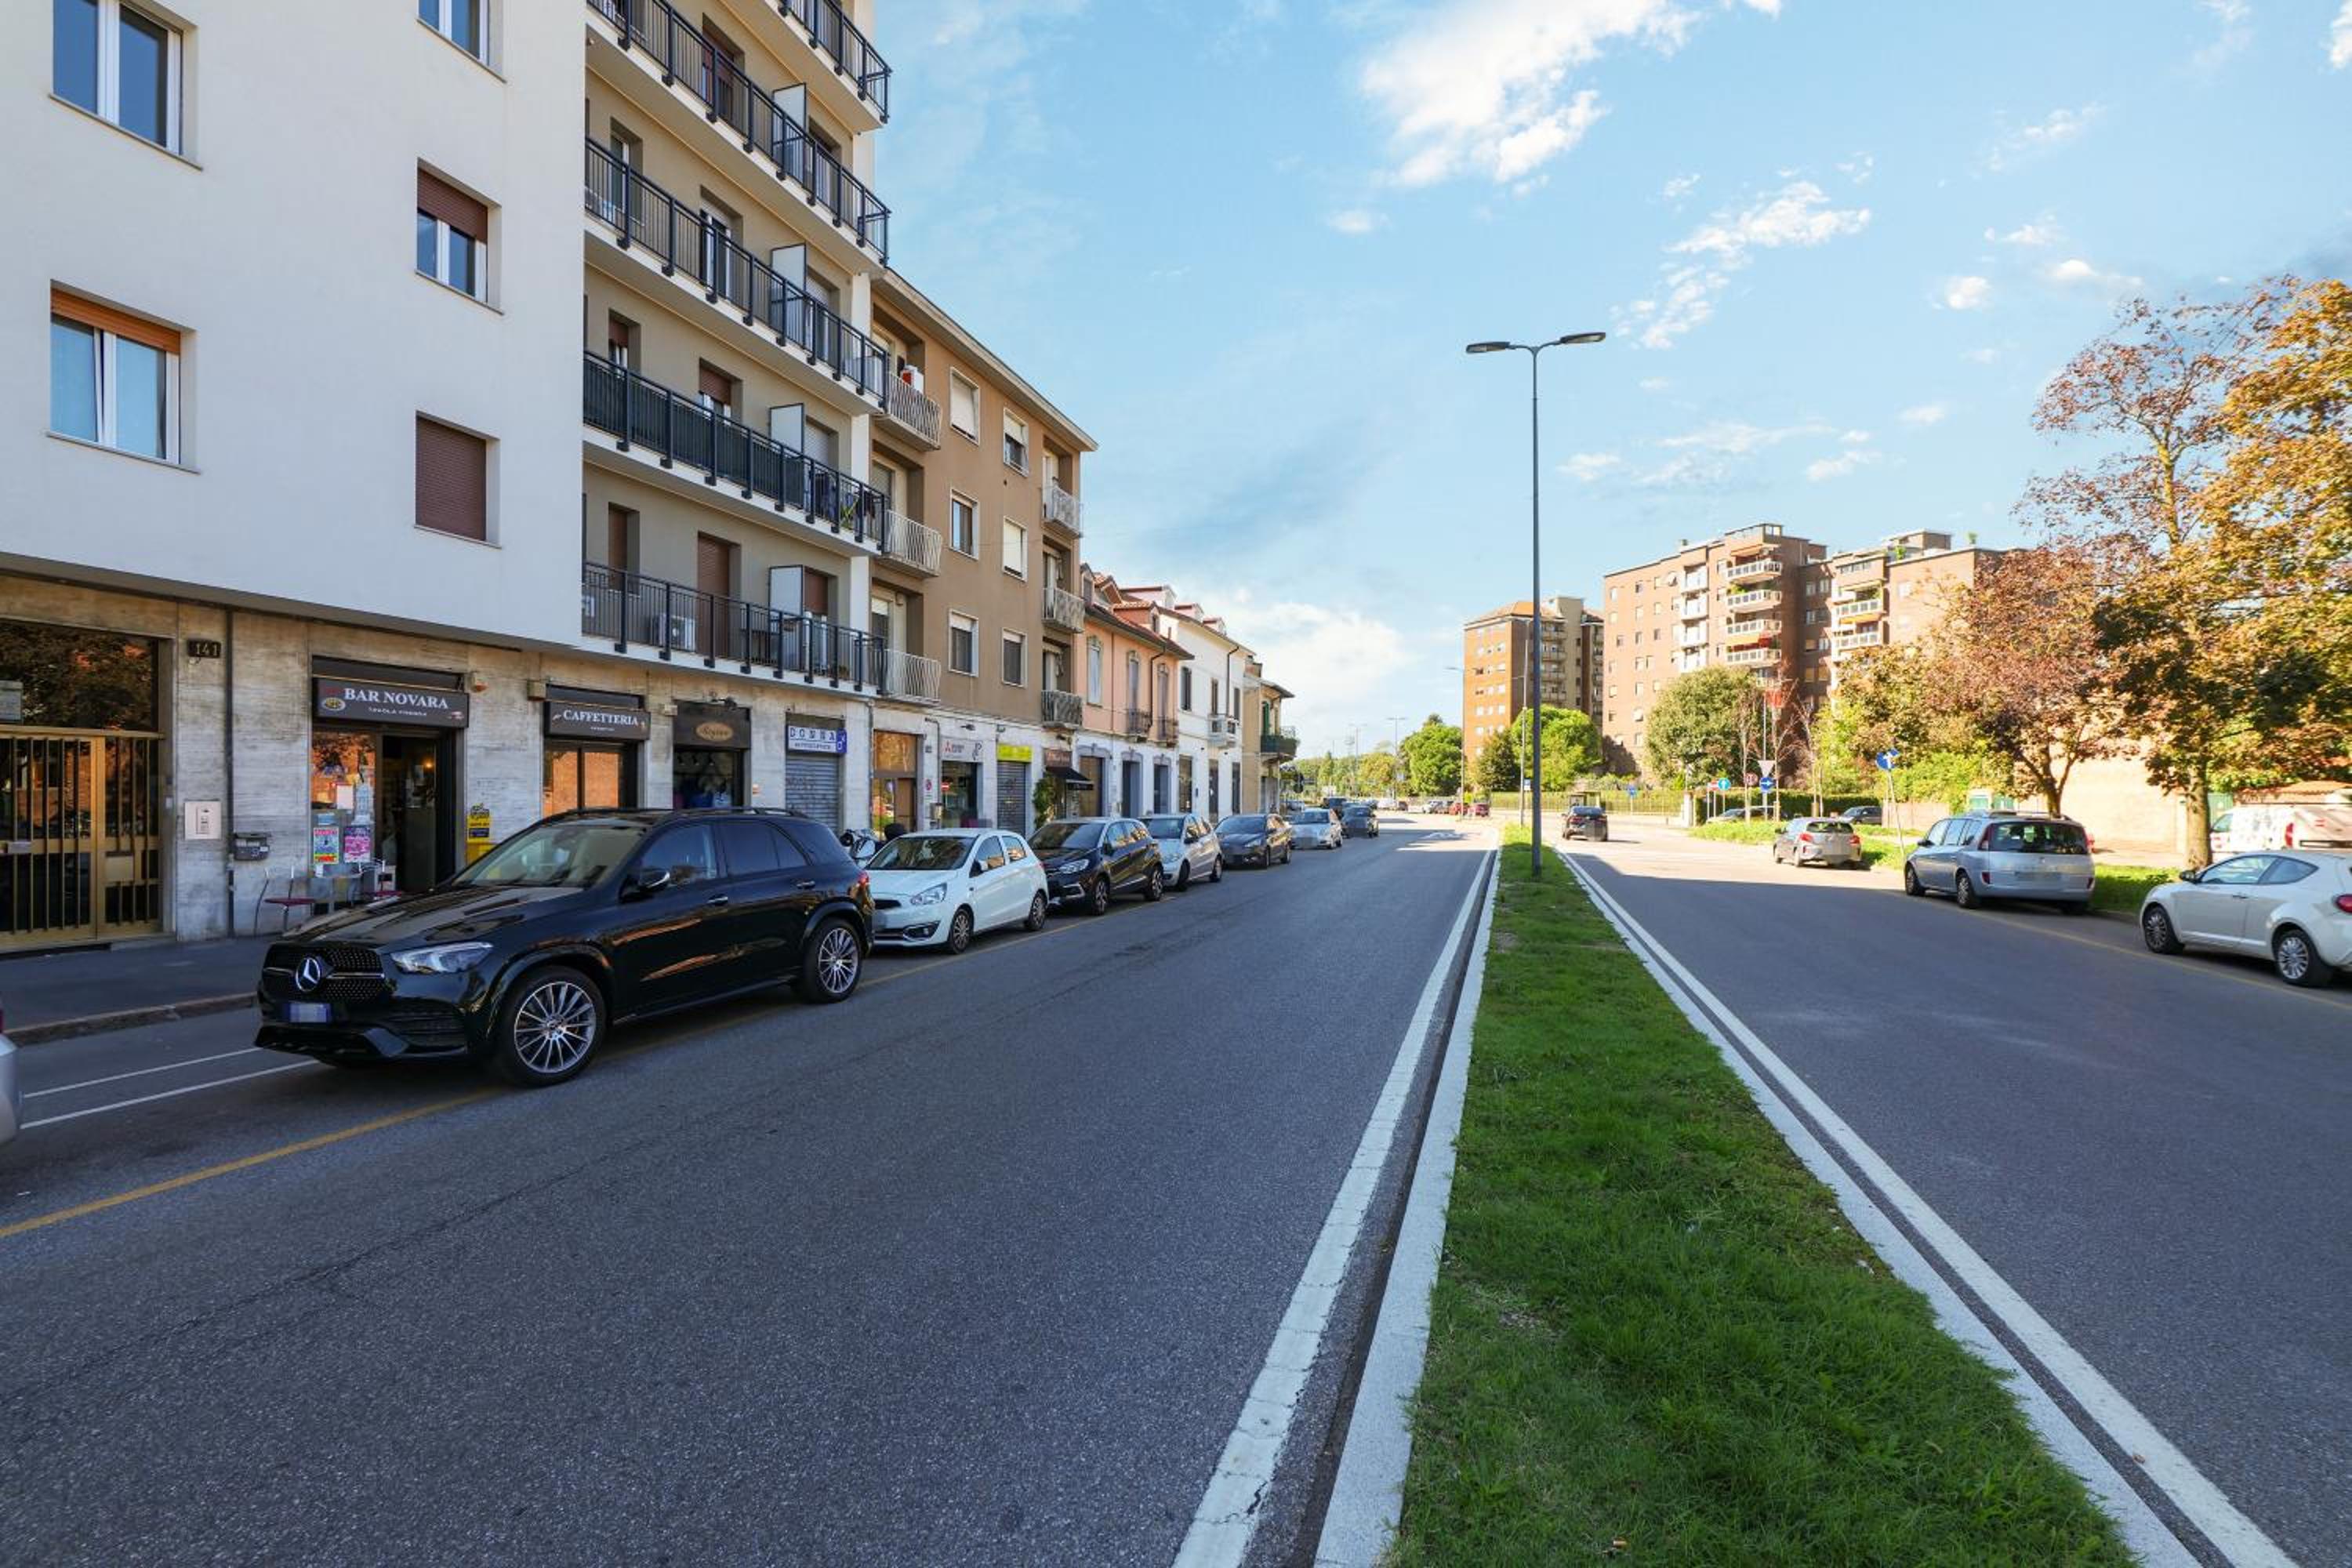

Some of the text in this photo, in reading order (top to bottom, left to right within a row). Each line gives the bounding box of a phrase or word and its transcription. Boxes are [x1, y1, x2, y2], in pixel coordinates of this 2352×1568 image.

[196, 643, 218, 656] 141
[343, 688, 449, 710] BAR NOVARA
[563, 710, 639, 726] CAFFETTERIA
